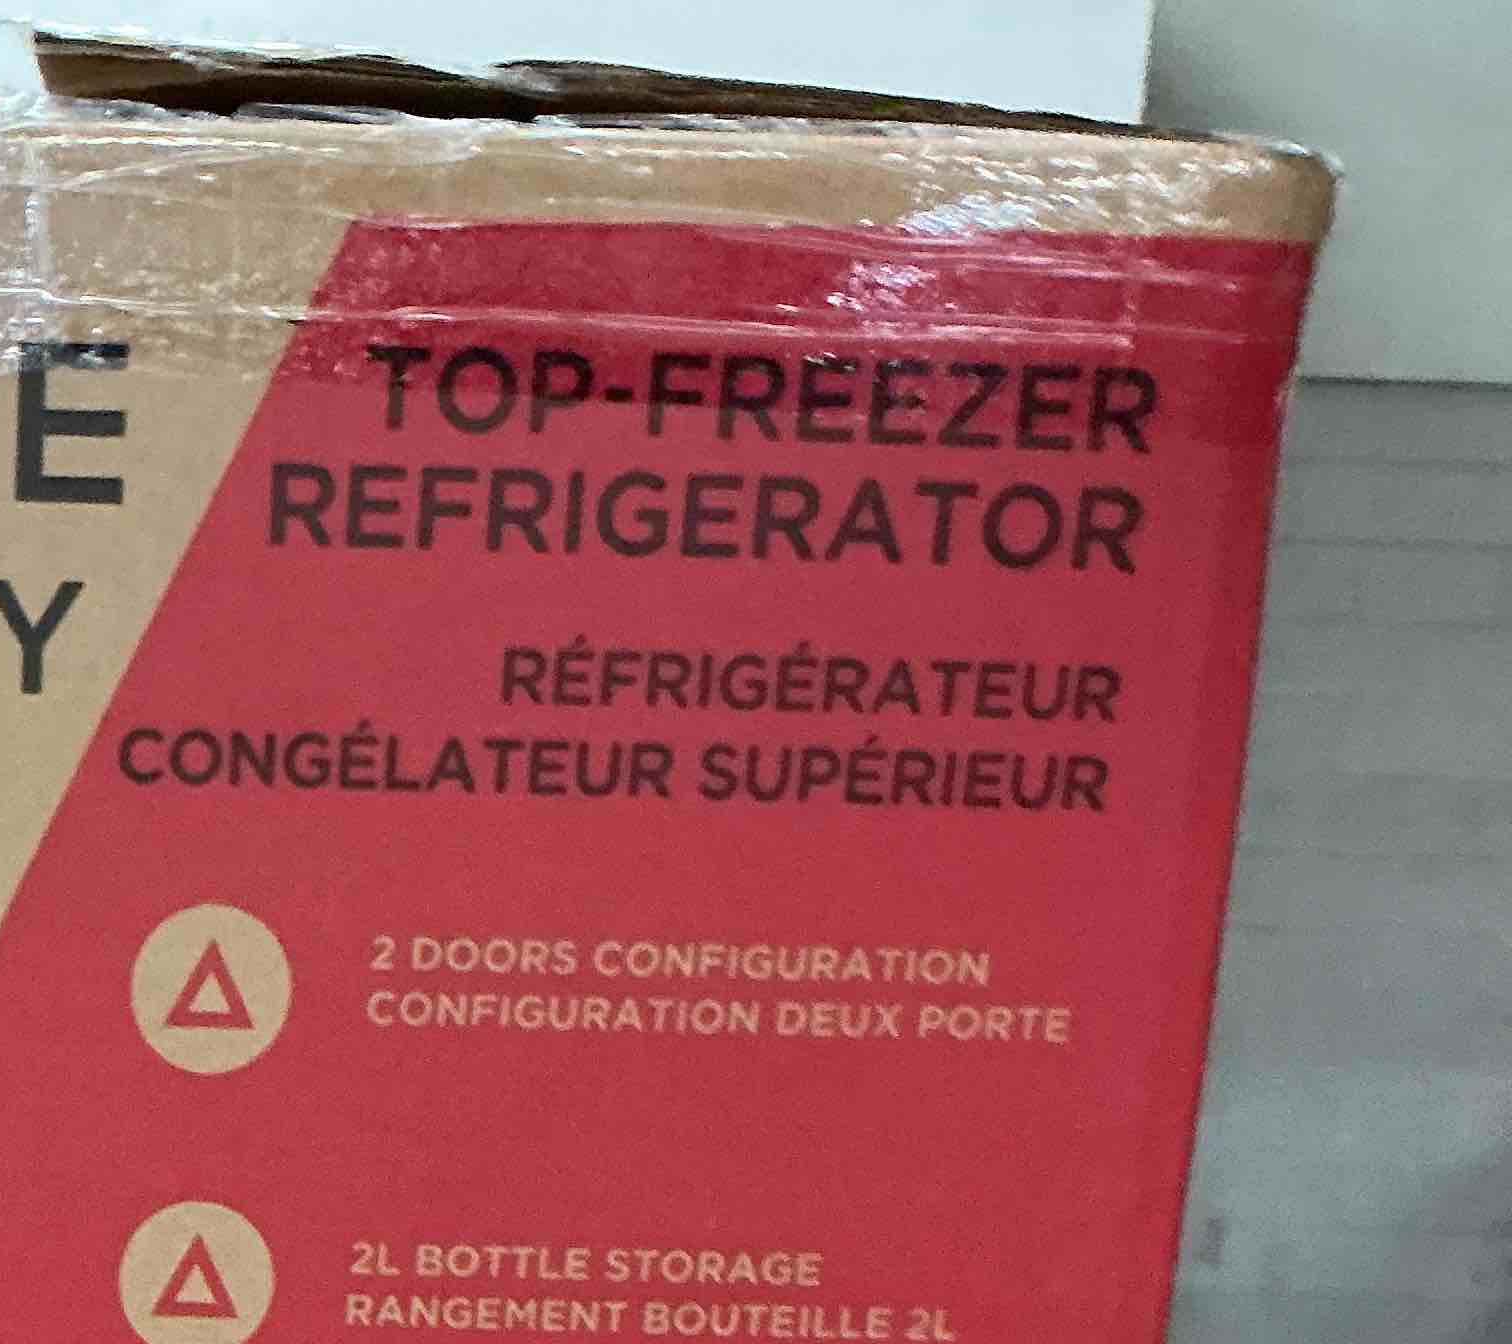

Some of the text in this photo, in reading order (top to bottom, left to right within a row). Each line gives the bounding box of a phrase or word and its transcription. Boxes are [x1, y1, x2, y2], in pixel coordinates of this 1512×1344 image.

[368, 342, 1159, 454] TOP-FREEZER
[270, 462, 1149, 577] REFRIGERATOR
[501, 634, 1124, 724] RÉFRIGÉRATEUR
[118, 719, 1109, 813] CONGÉLATEUR SUPÉRIEUR
[370, 935, 990, 986] 2 DOORS CONFIGURATION
[366, 990, 1071, 1043] CONFIGURATION DEUX PORTE
[350, 1241, 823, 1287] 2L BOTTLE STORAGE
[345, 1293, 955, 1342] RANGEMENT BOUTEILLE 2L
